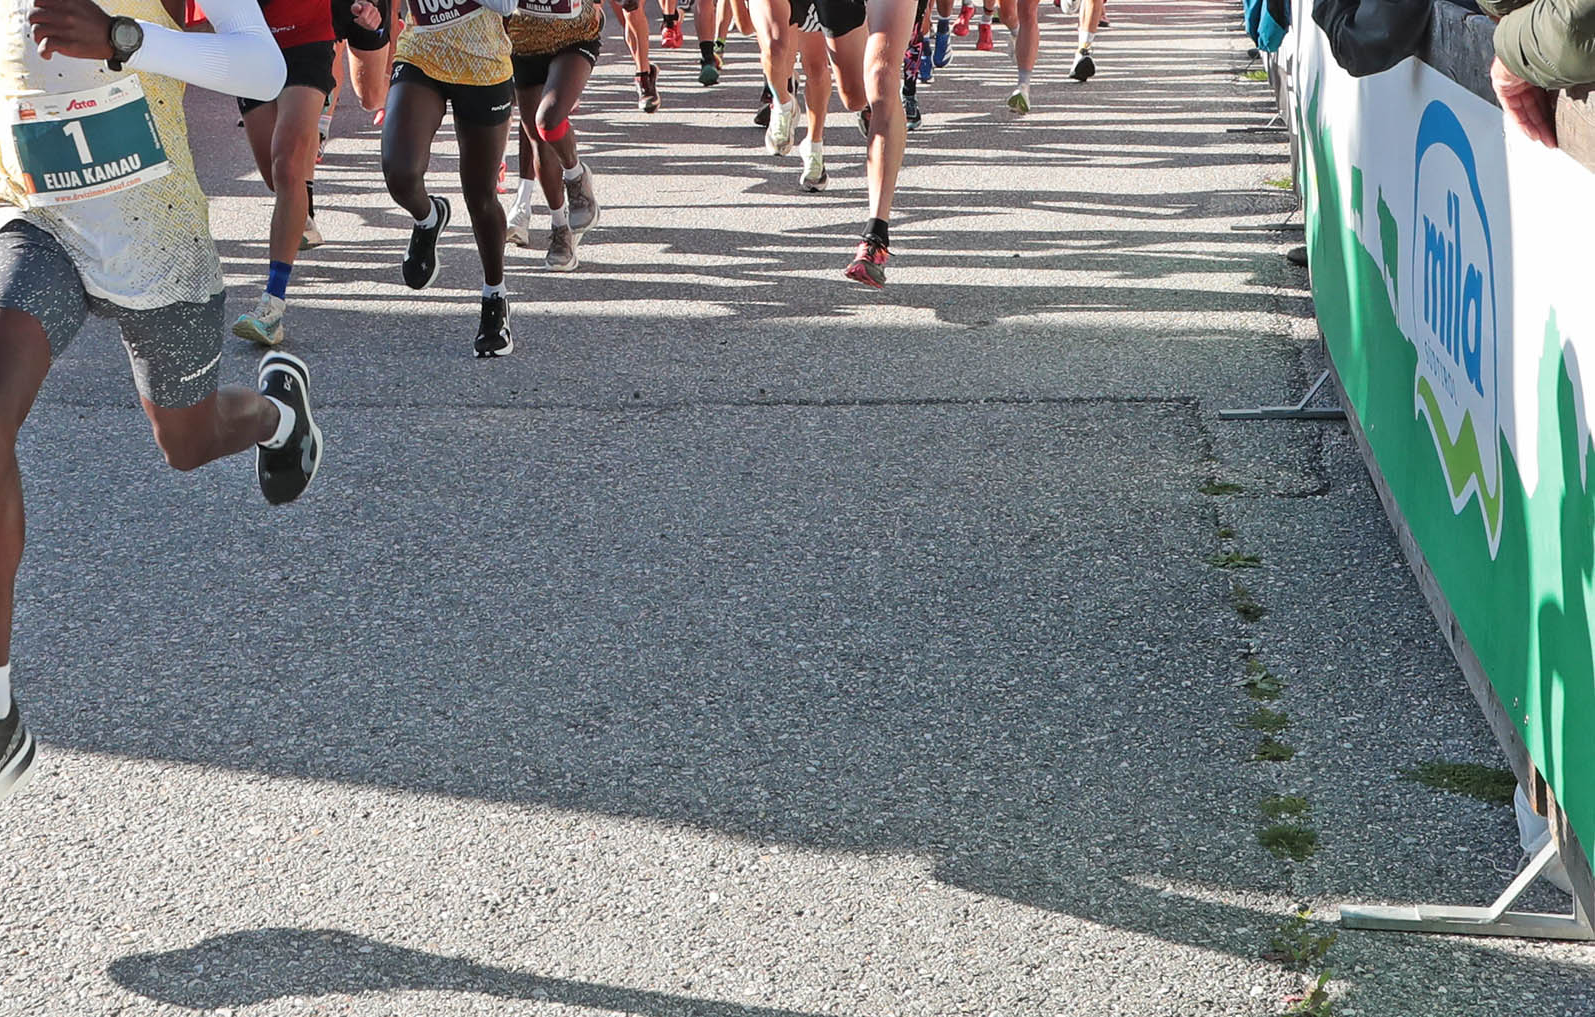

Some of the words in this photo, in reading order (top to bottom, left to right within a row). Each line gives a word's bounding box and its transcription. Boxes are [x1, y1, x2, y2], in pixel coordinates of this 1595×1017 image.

[429, 8, 461, 24] GLORIA
[62, 120, 94, 165] 1
[43, 171, 83, 190] ELIJA
[82, 153, 142, 184] KAMAU
[1423, 189, 1484, 398] mila
